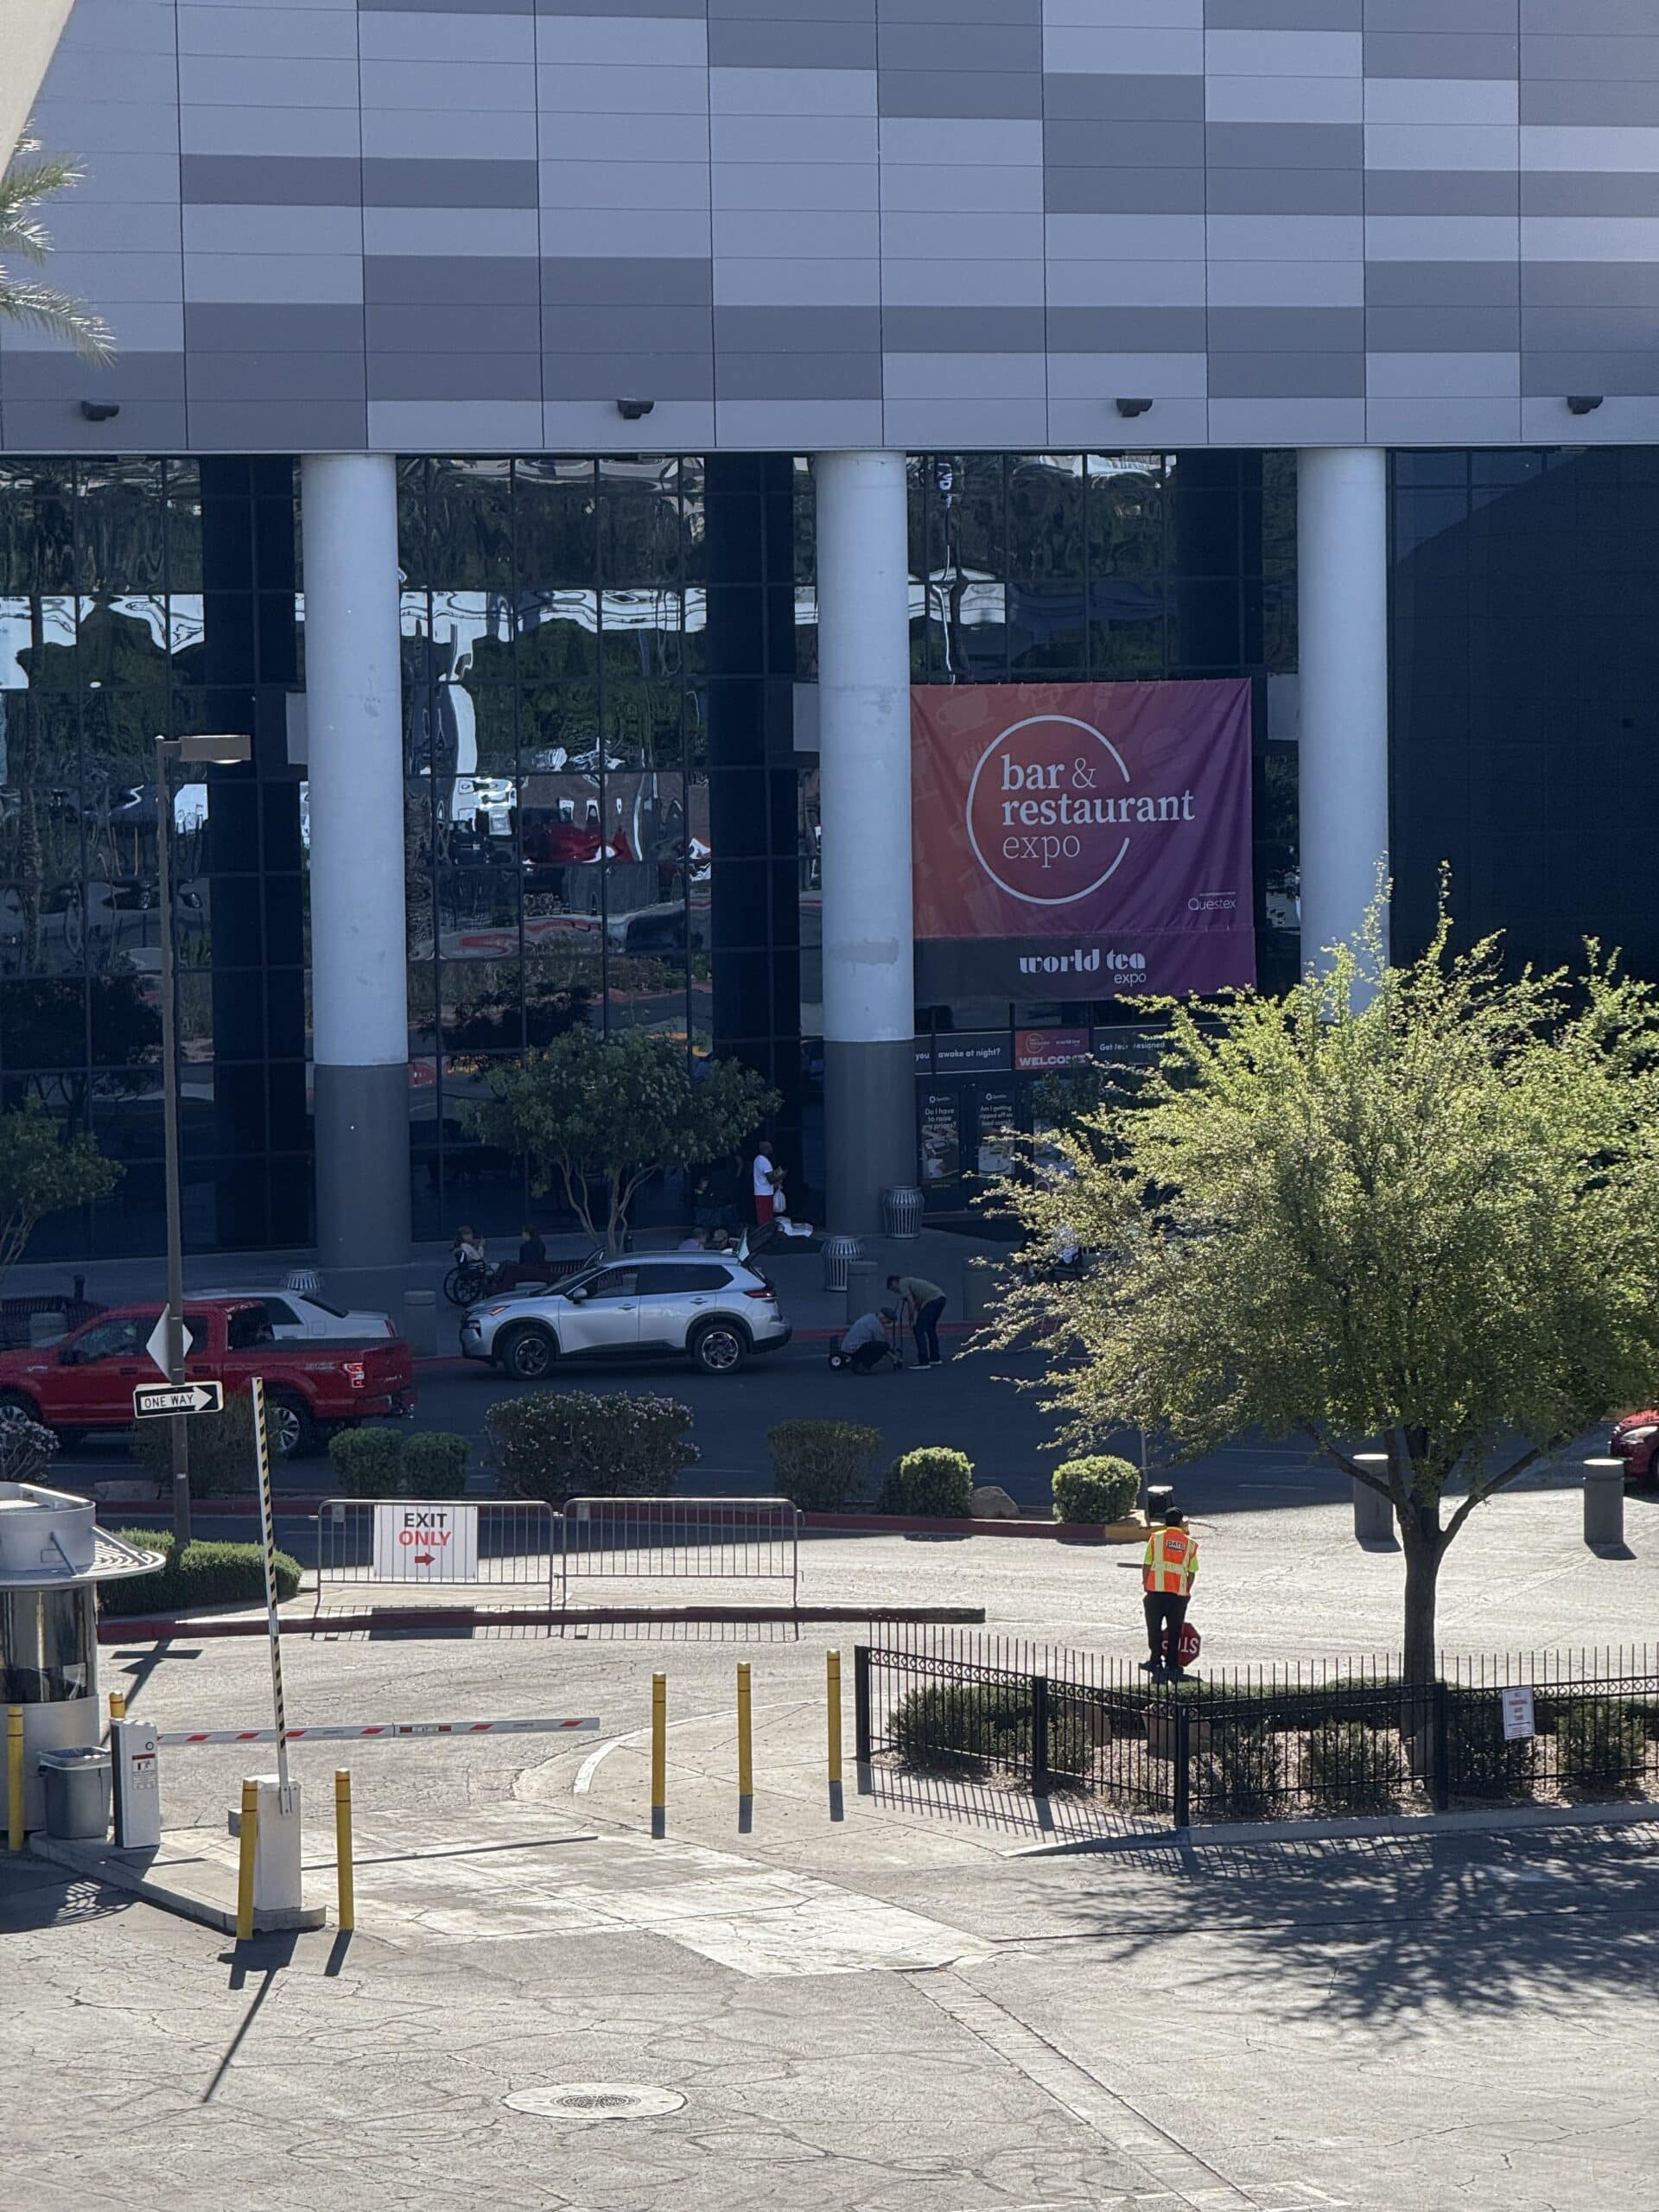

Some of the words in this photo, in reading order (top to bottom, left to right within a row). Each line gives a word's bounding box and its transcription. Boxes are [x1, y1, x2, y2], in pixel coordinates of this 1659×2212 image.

[1001, 753, 1065, 791] bar
[1071, 757, 1096, 789] &
[1001, 790, 1195, 826] restaurant
[1002, 835, 1080, 868] expo
[1187, 897, 1236, 912] Questex
[1019, 949, 1100, 974] world
[1105, 950, 1146, 970] tea
[1114, 972, 1147, 987] expo
[915, 1052, 930, 1061] you
[976, 1047, 1001, 1058] night?
[144, 1395, 167, 1408] ONE
[169, 1393, 194, 1407] WAY
[404, 1513, 448, 1529] EXIT
[398, 1531, 452, 1547] ONLY
